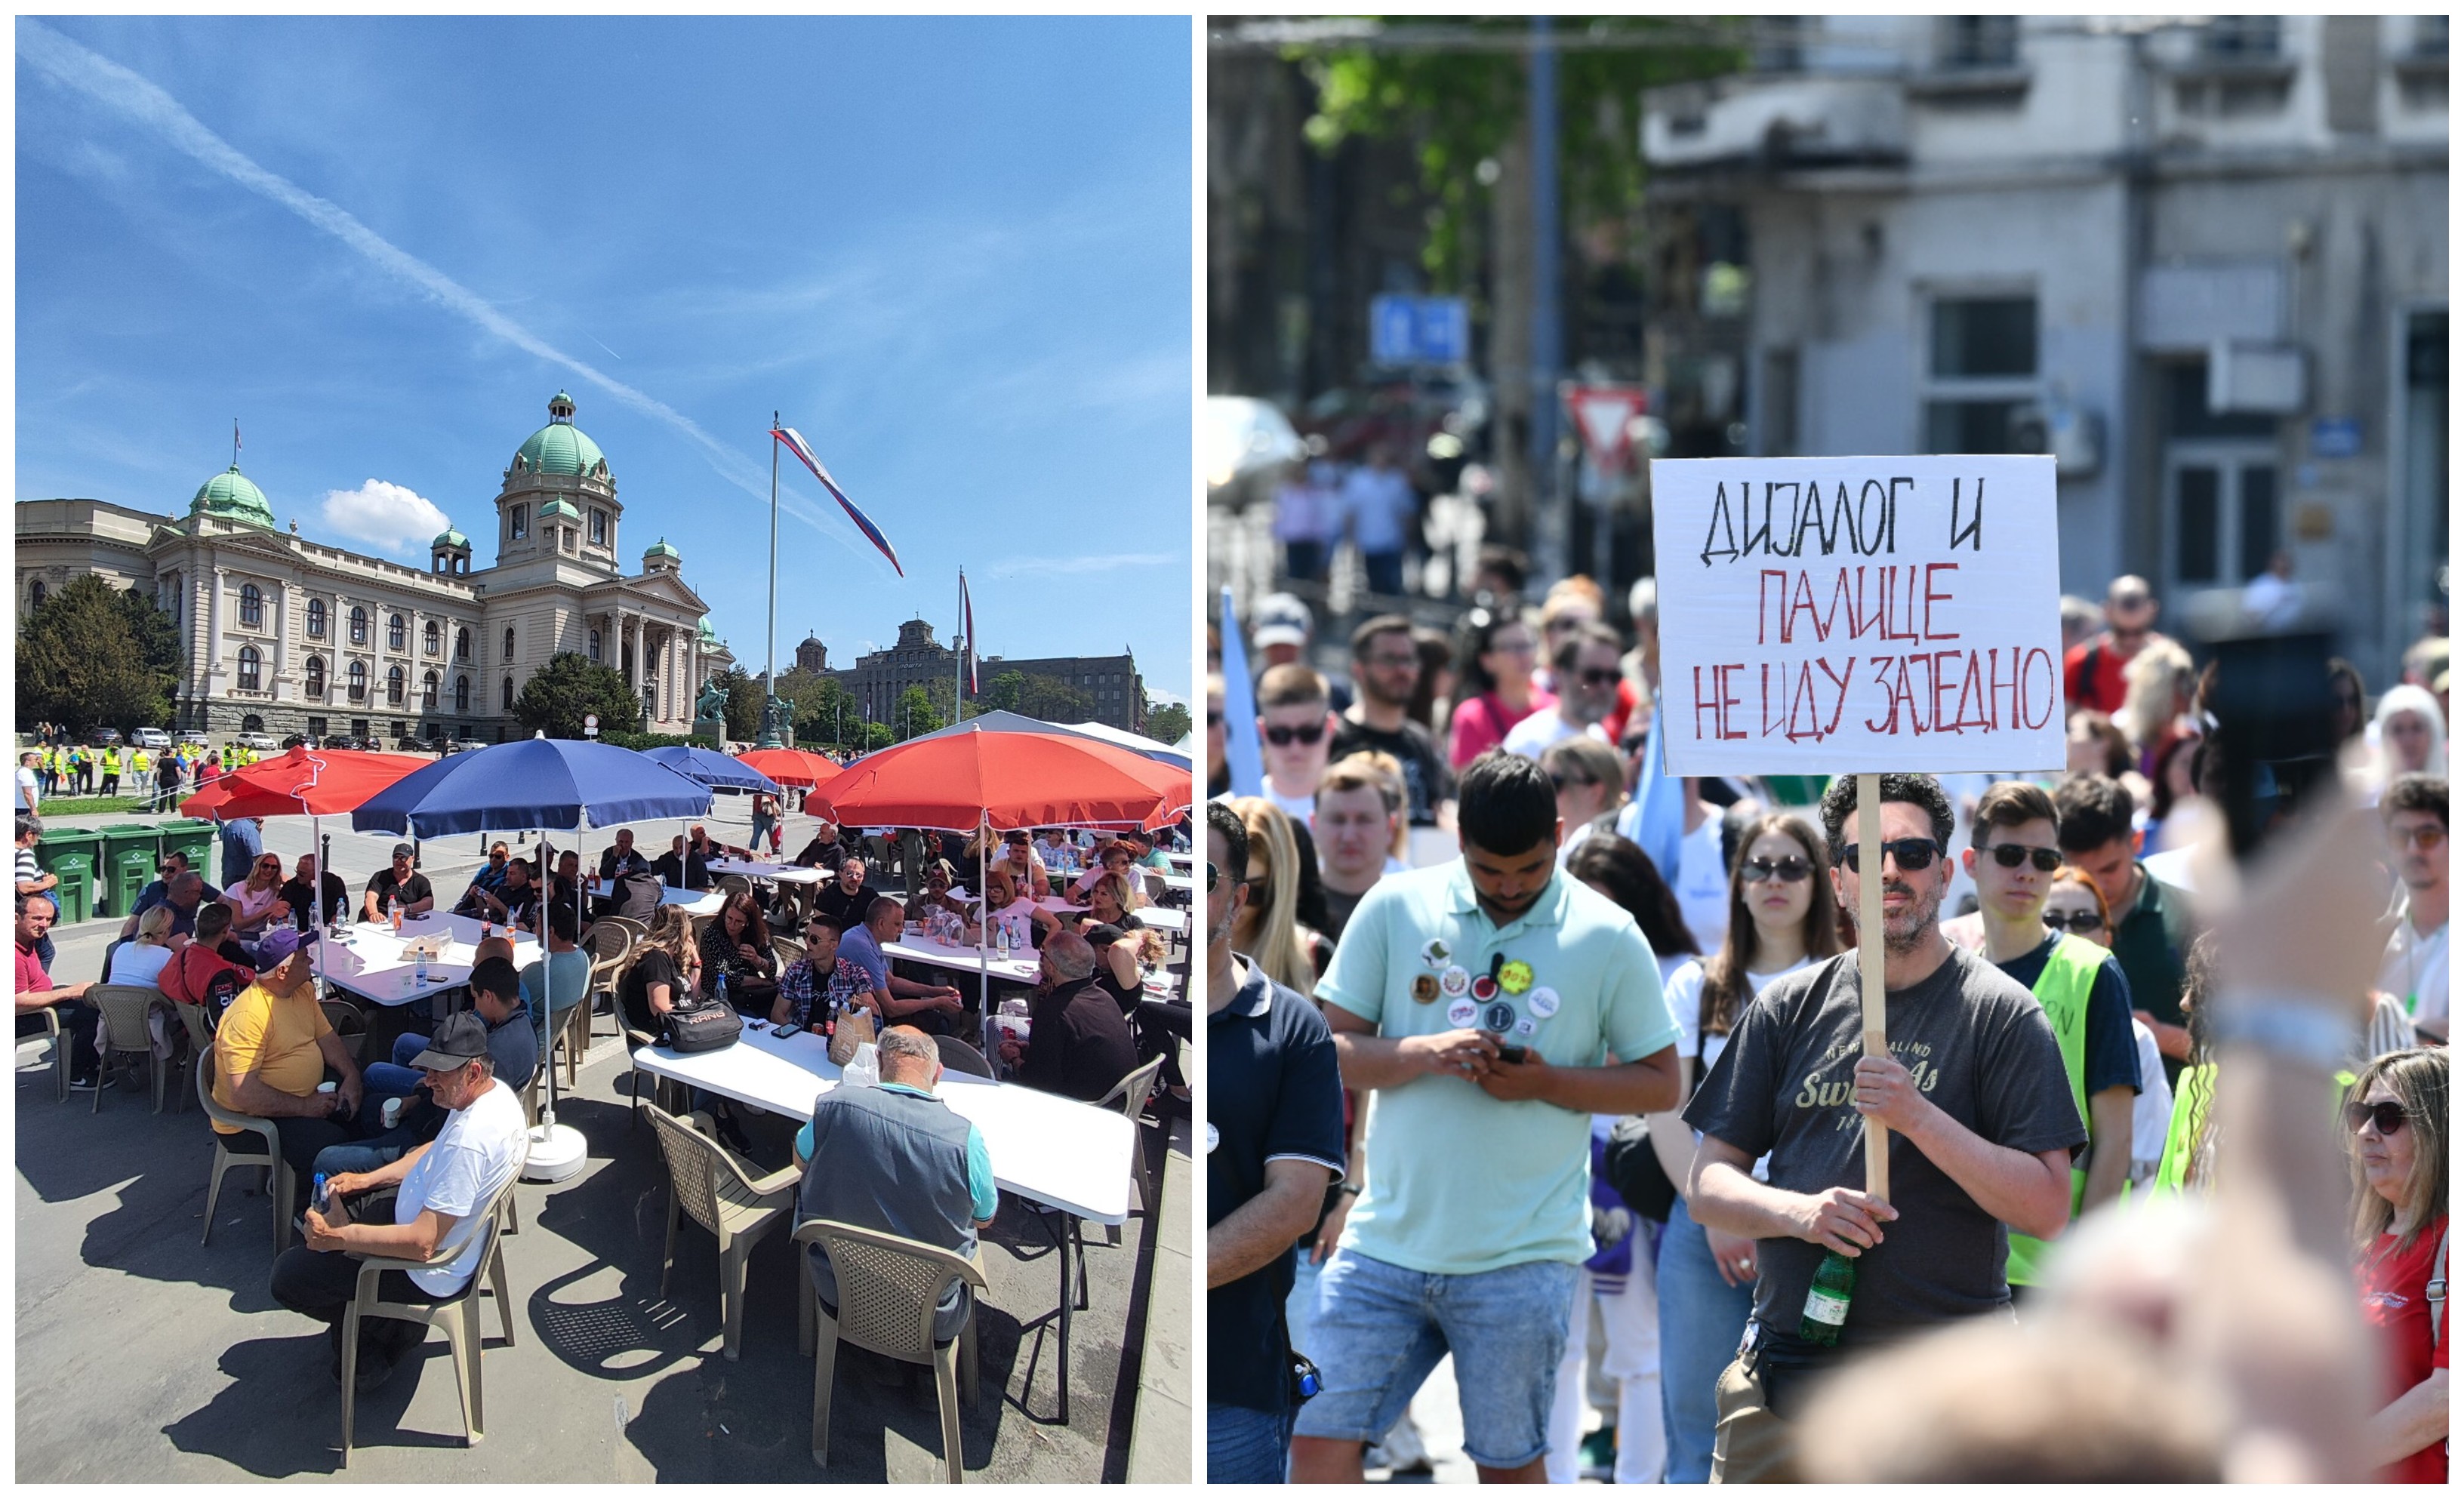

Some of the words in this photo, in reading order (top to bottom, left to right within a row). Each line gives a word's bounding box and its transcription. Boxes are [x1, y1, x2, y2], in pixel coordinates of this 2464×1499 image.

[1700, 476, 1914, 568] ДИЈАЛОГ
[1950, 477, 1985, 551] И
[1757, 563, 1960, 645] ПАЛИЦЕ
[1693, 663, 1747, 740] НЕ
[1761, 656, 1856, 743] ИДУ
[1865, 647, 2053, 737] ЗАЈЕДНО
[689, 1010, 725, 1024] RANG
[1825, 1042, 1861, 1060] NEW
[1885, 1042, 1932, 1057] ALND
